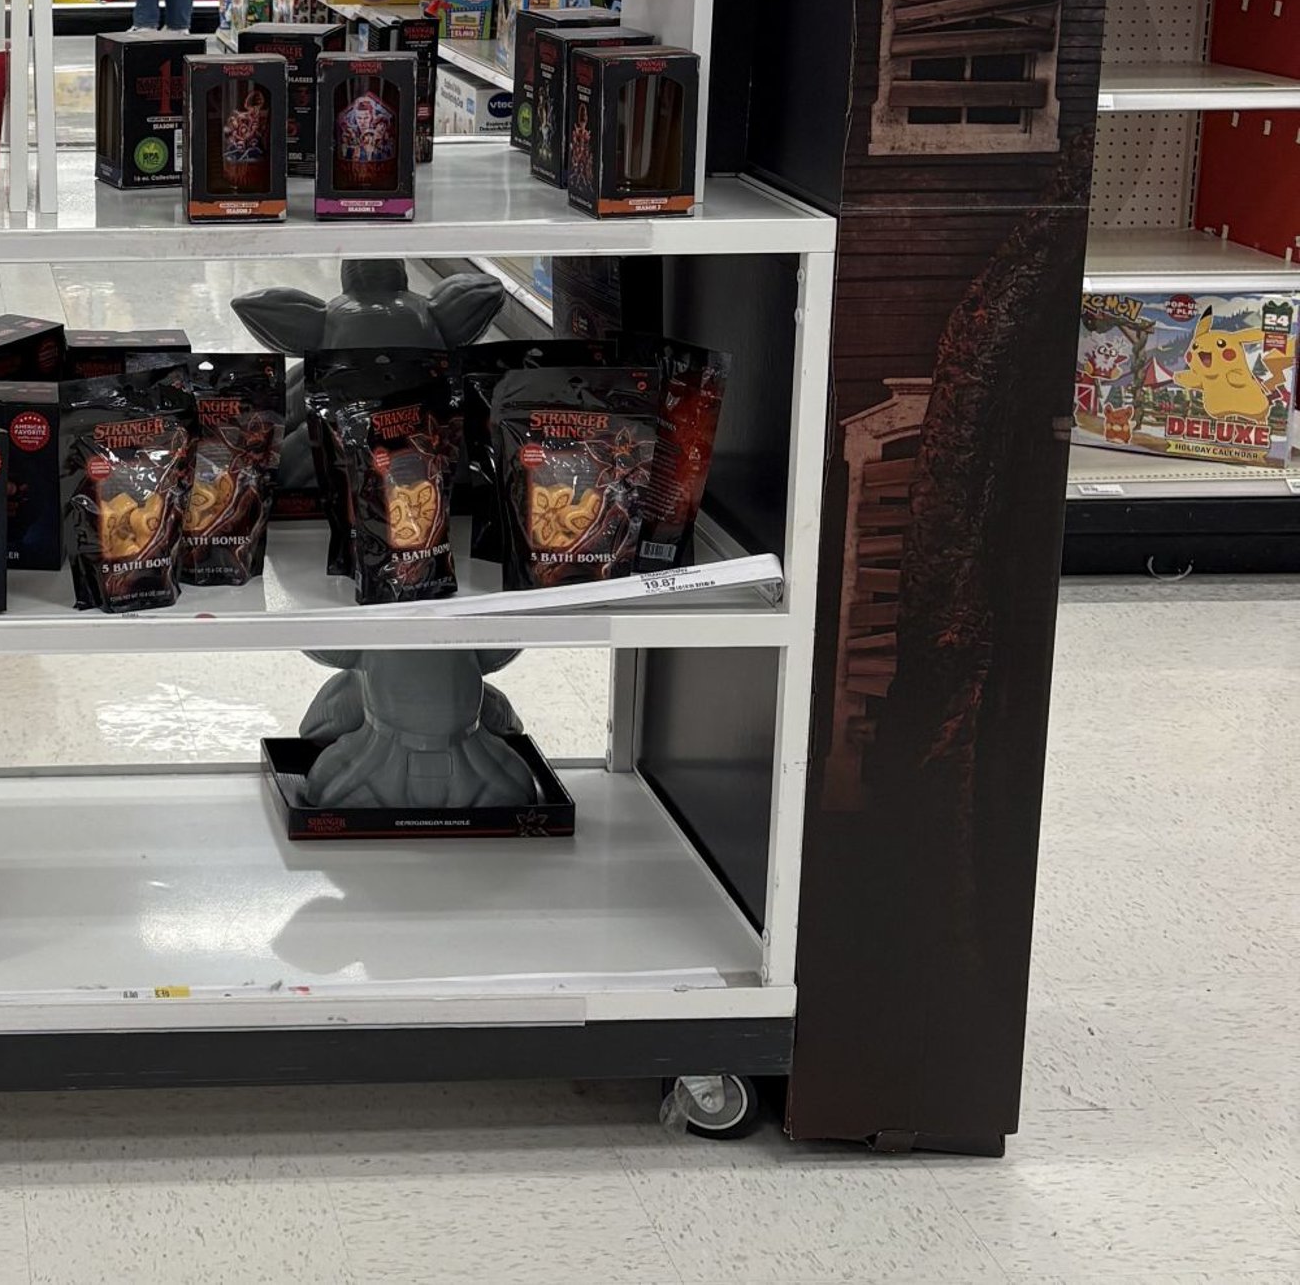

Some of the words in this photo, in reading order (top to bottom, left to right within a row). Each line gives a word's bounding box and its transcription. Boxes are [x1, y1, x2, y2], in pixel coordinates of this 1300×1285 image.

[1264, 314, 1290, 326] 24
[372, 404, 421, 429] STRANGER
[529, 410, 611, 430] STRANGER
[93, 418, 166, 440] STRANGER
[542, 425, 597, 438] THINGS
[1166, 416, 1271, 447] DELUXE
[104, 433, 155, 448] THINGS
[1175, 443, 1212, 454] HOLIDAY
[1212, 448, 1258, 459] CALENDAR
[212, 535, 251, 545] BOMBS
[391, 552, 398, 562] 5
[402, 548, 432, 563] BATH
[530, 553, 537, 562] 5
[541, 552, 573, 563] BATH
[577, 553, 617, 563] BOMBS
[102, 564, 109, 573] 5
[113, 561, 142, 573] BATH
[644, 577, 676, 590] 19.87
